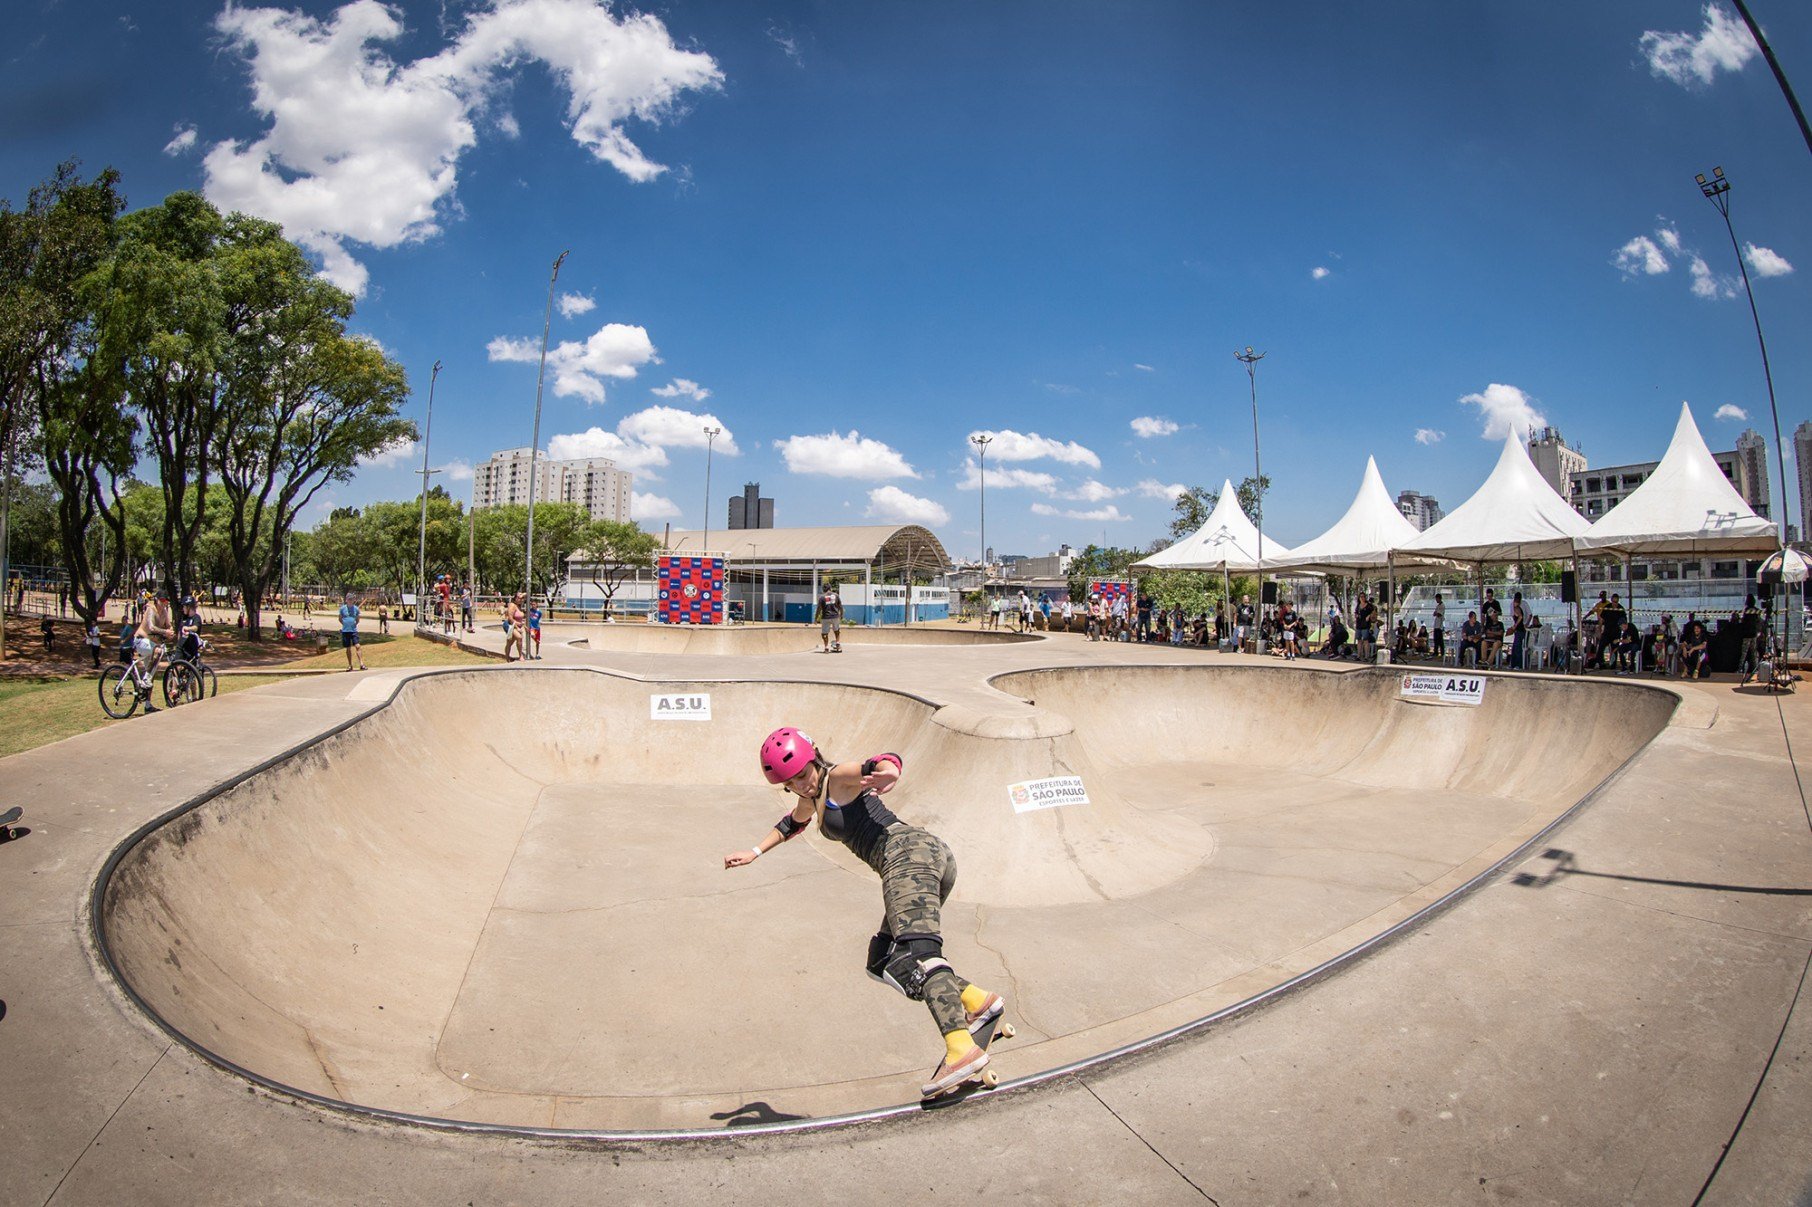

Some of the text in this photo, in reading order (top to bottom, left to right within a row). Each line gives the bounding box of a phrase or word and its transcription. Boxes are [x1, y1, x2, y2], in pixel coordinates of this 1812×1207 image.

[1445, 679, 1481, 693] A.S.U.
[657, 697, 706, 710] A.S.U.
[1029, 779, 1082, 790] PREFEITURA DE
[1032, 787, 1085, 801] SÃO PAULO
